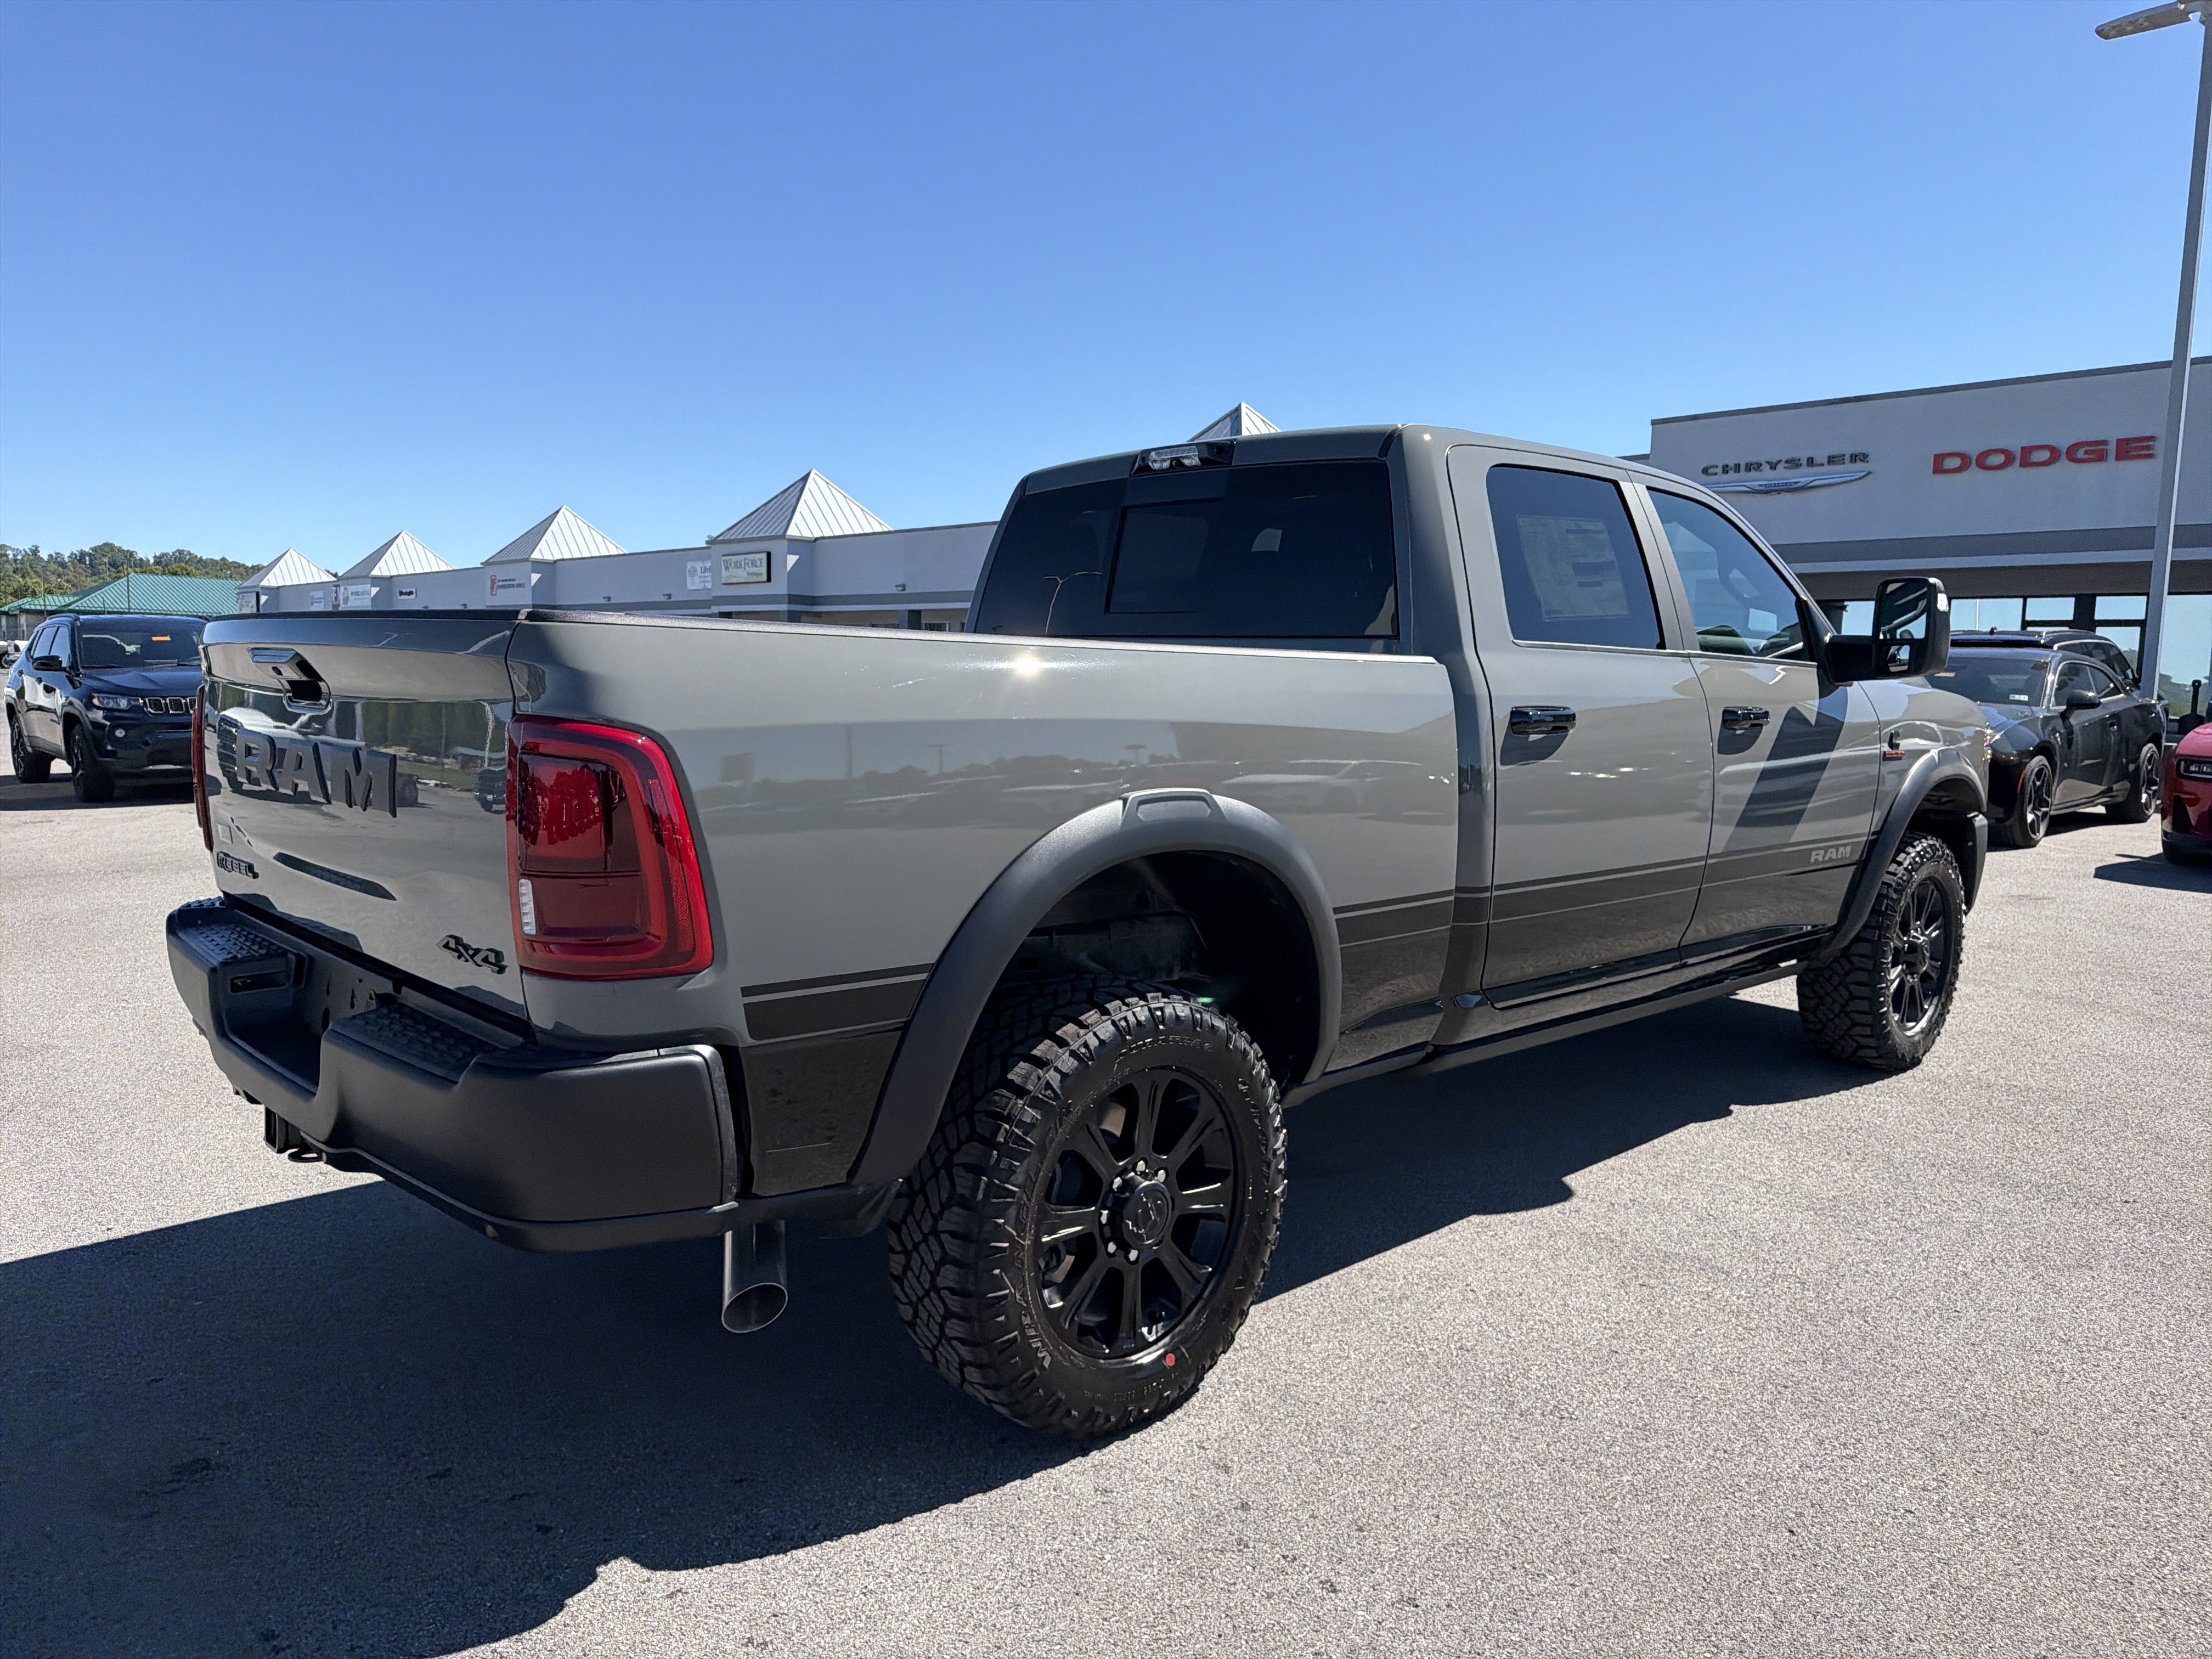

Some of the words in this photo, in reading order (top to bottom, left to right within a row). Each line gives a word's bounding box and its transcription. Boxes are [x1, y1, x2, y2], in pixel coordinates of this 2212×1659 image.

[1701, 452, 1869, 476] CHRYSLER
[1932, 436, 2157, 475] DODGE
[235, 728, 397, 817] RAM
[217, 851, 259, 879] REBEL
[1810, 845, 1852, 862] RAM
